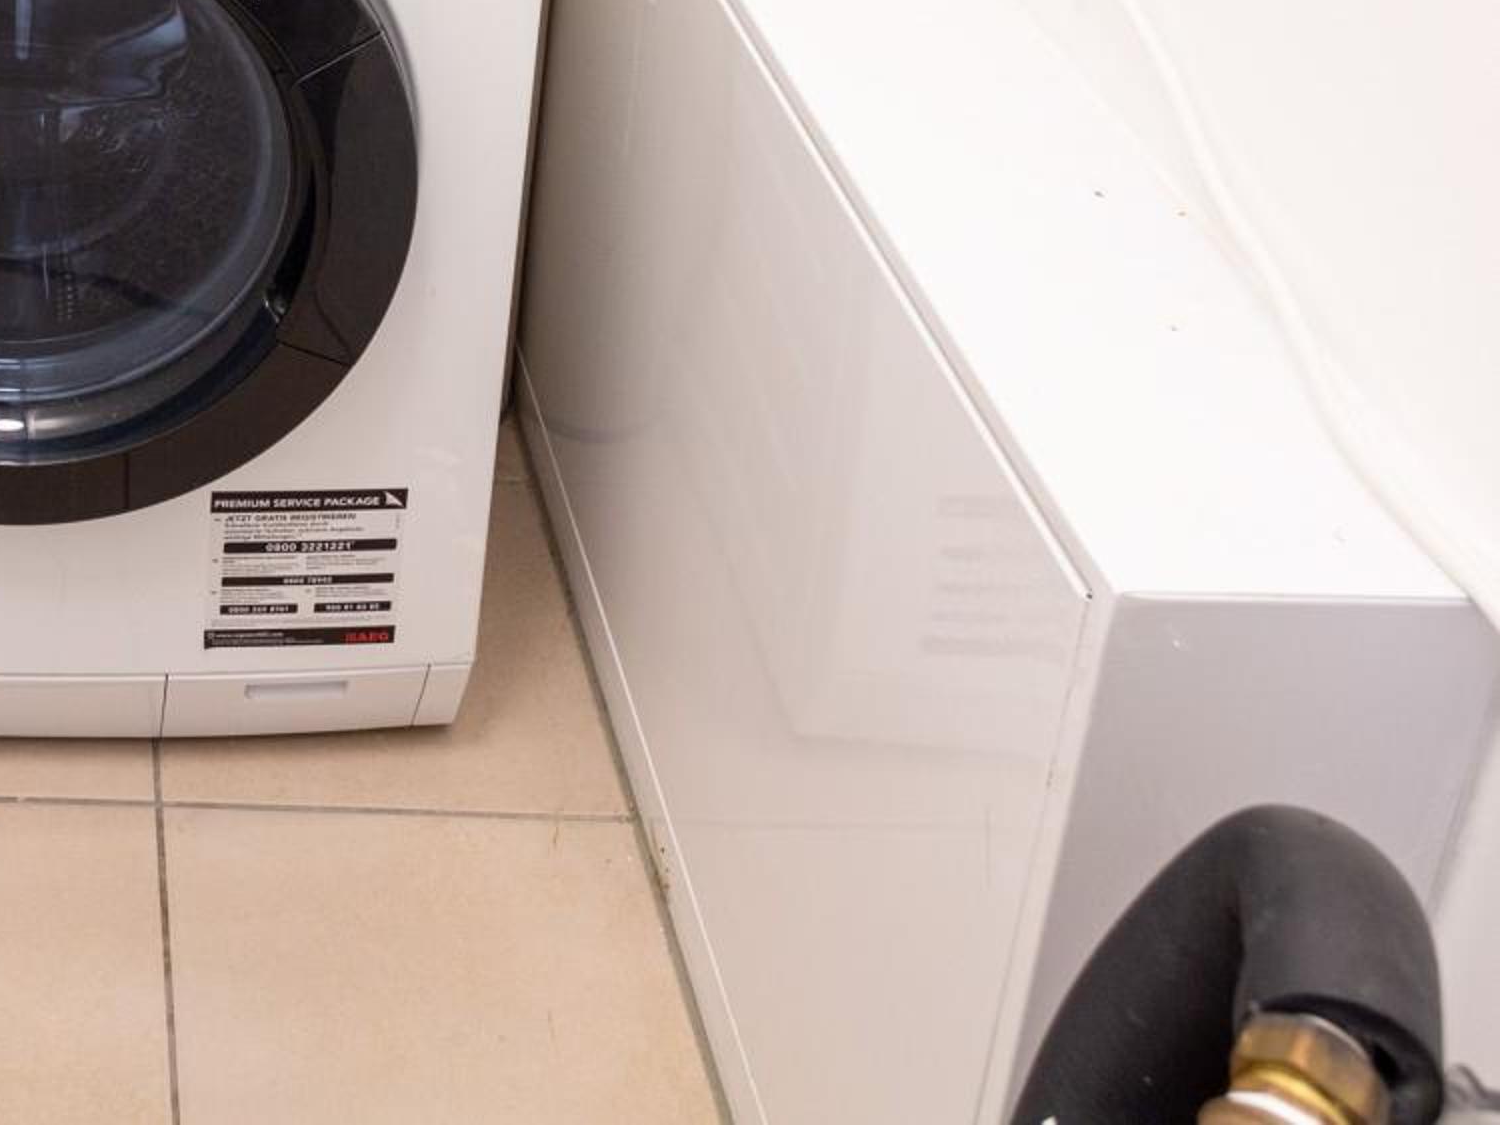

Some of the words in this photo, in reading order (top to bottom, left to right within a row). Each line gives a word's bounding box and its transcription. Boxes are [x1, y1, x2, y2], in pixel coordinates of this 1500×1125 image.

[214, 498, 270, 509] PREMIUM
[274, 497, 321, 508] SERVICE
[324, 496, 381, 507] PACKAGE
